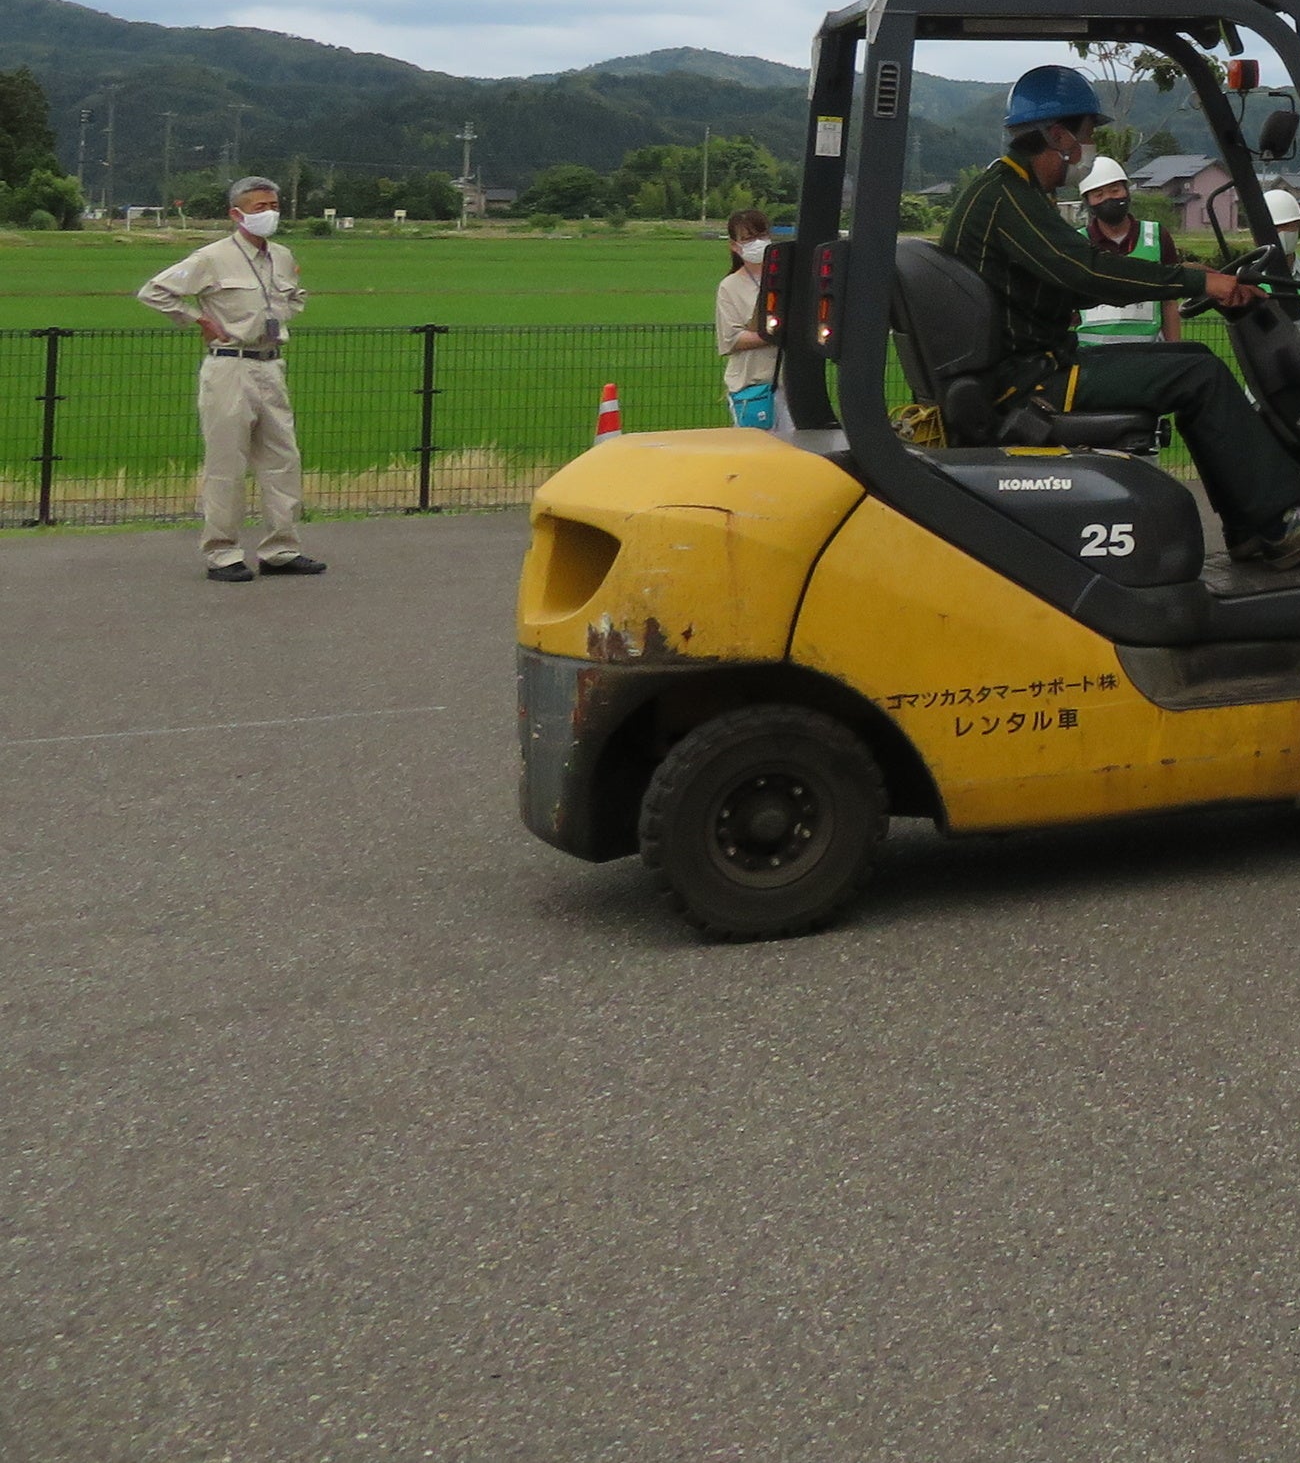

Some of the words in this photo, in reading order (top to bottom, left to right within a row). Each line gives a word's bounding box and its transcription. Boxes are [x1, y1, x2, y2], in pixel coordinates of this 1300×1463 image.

[999, 476, 1072, 491] KOMATSU
[1080, 523, 1136, 556] 25
[954, 709, 1079, 738] レンタル車
